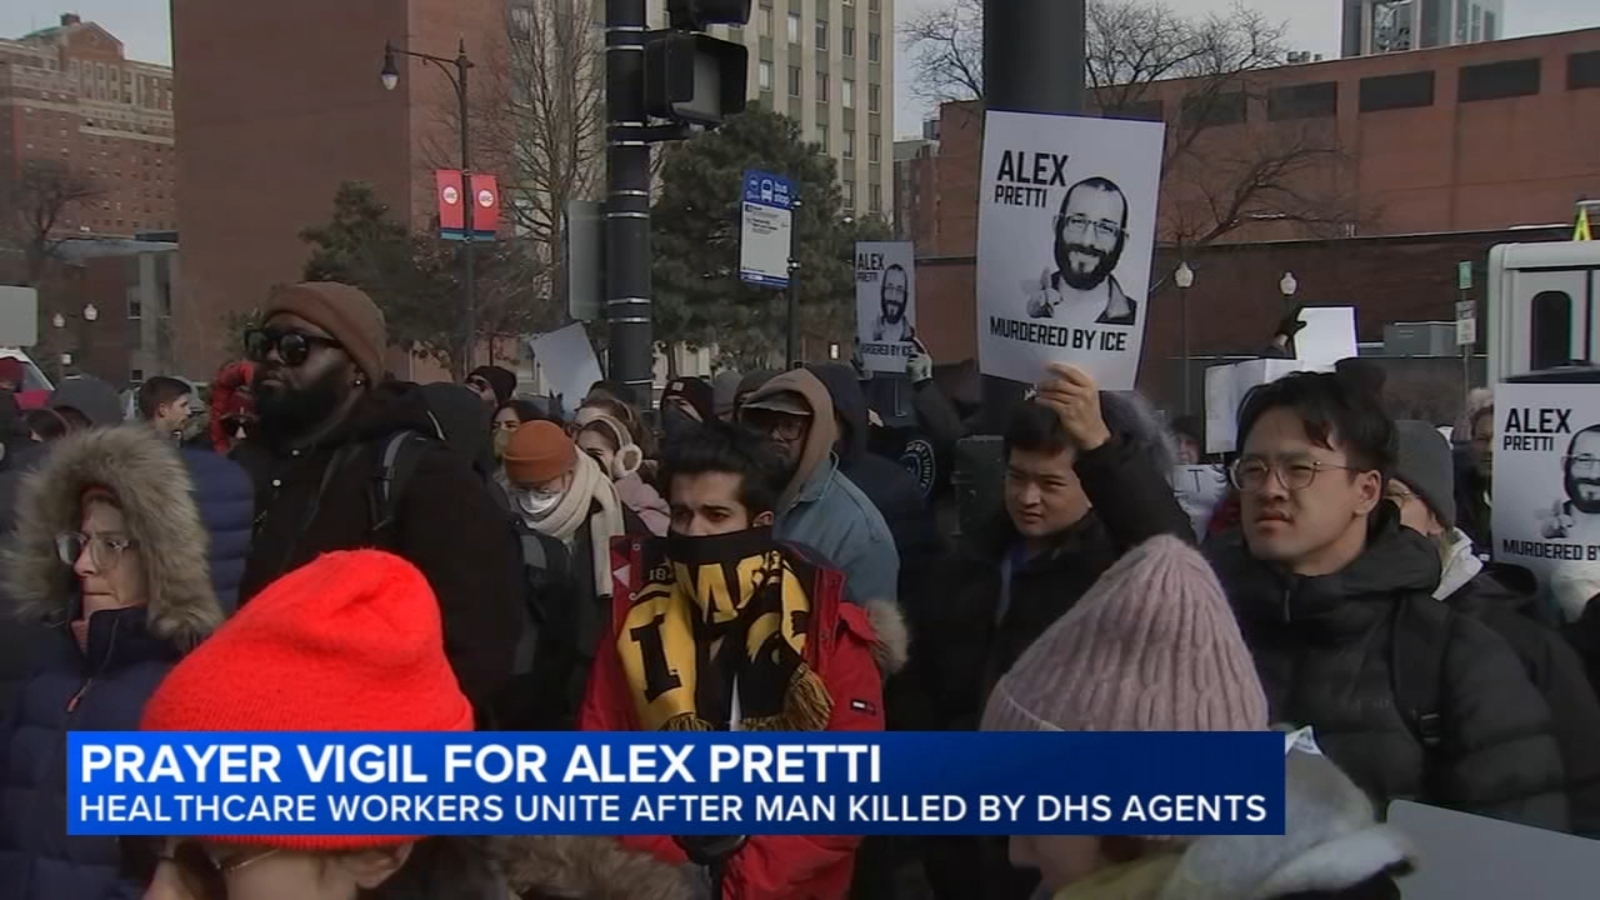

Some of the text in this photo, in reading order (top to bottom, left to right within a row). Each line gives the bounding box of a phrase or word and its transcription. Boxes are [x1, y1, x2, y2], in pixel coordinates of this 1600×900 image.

[996, 149, 1069, 187] ALEX
[774, 180, 788, 194] bus
[994, 184, 1047, 208] PRETTI
[857, 253, 885, 271] ALEX
[990, 316, 1127, 352] MURDERED BY ICE
[1504, 408, 1572, 434] ALEX
[1503, 435, 1554, 452] PRETTI
[1502, 539, 1600, 561] MURDERED B
